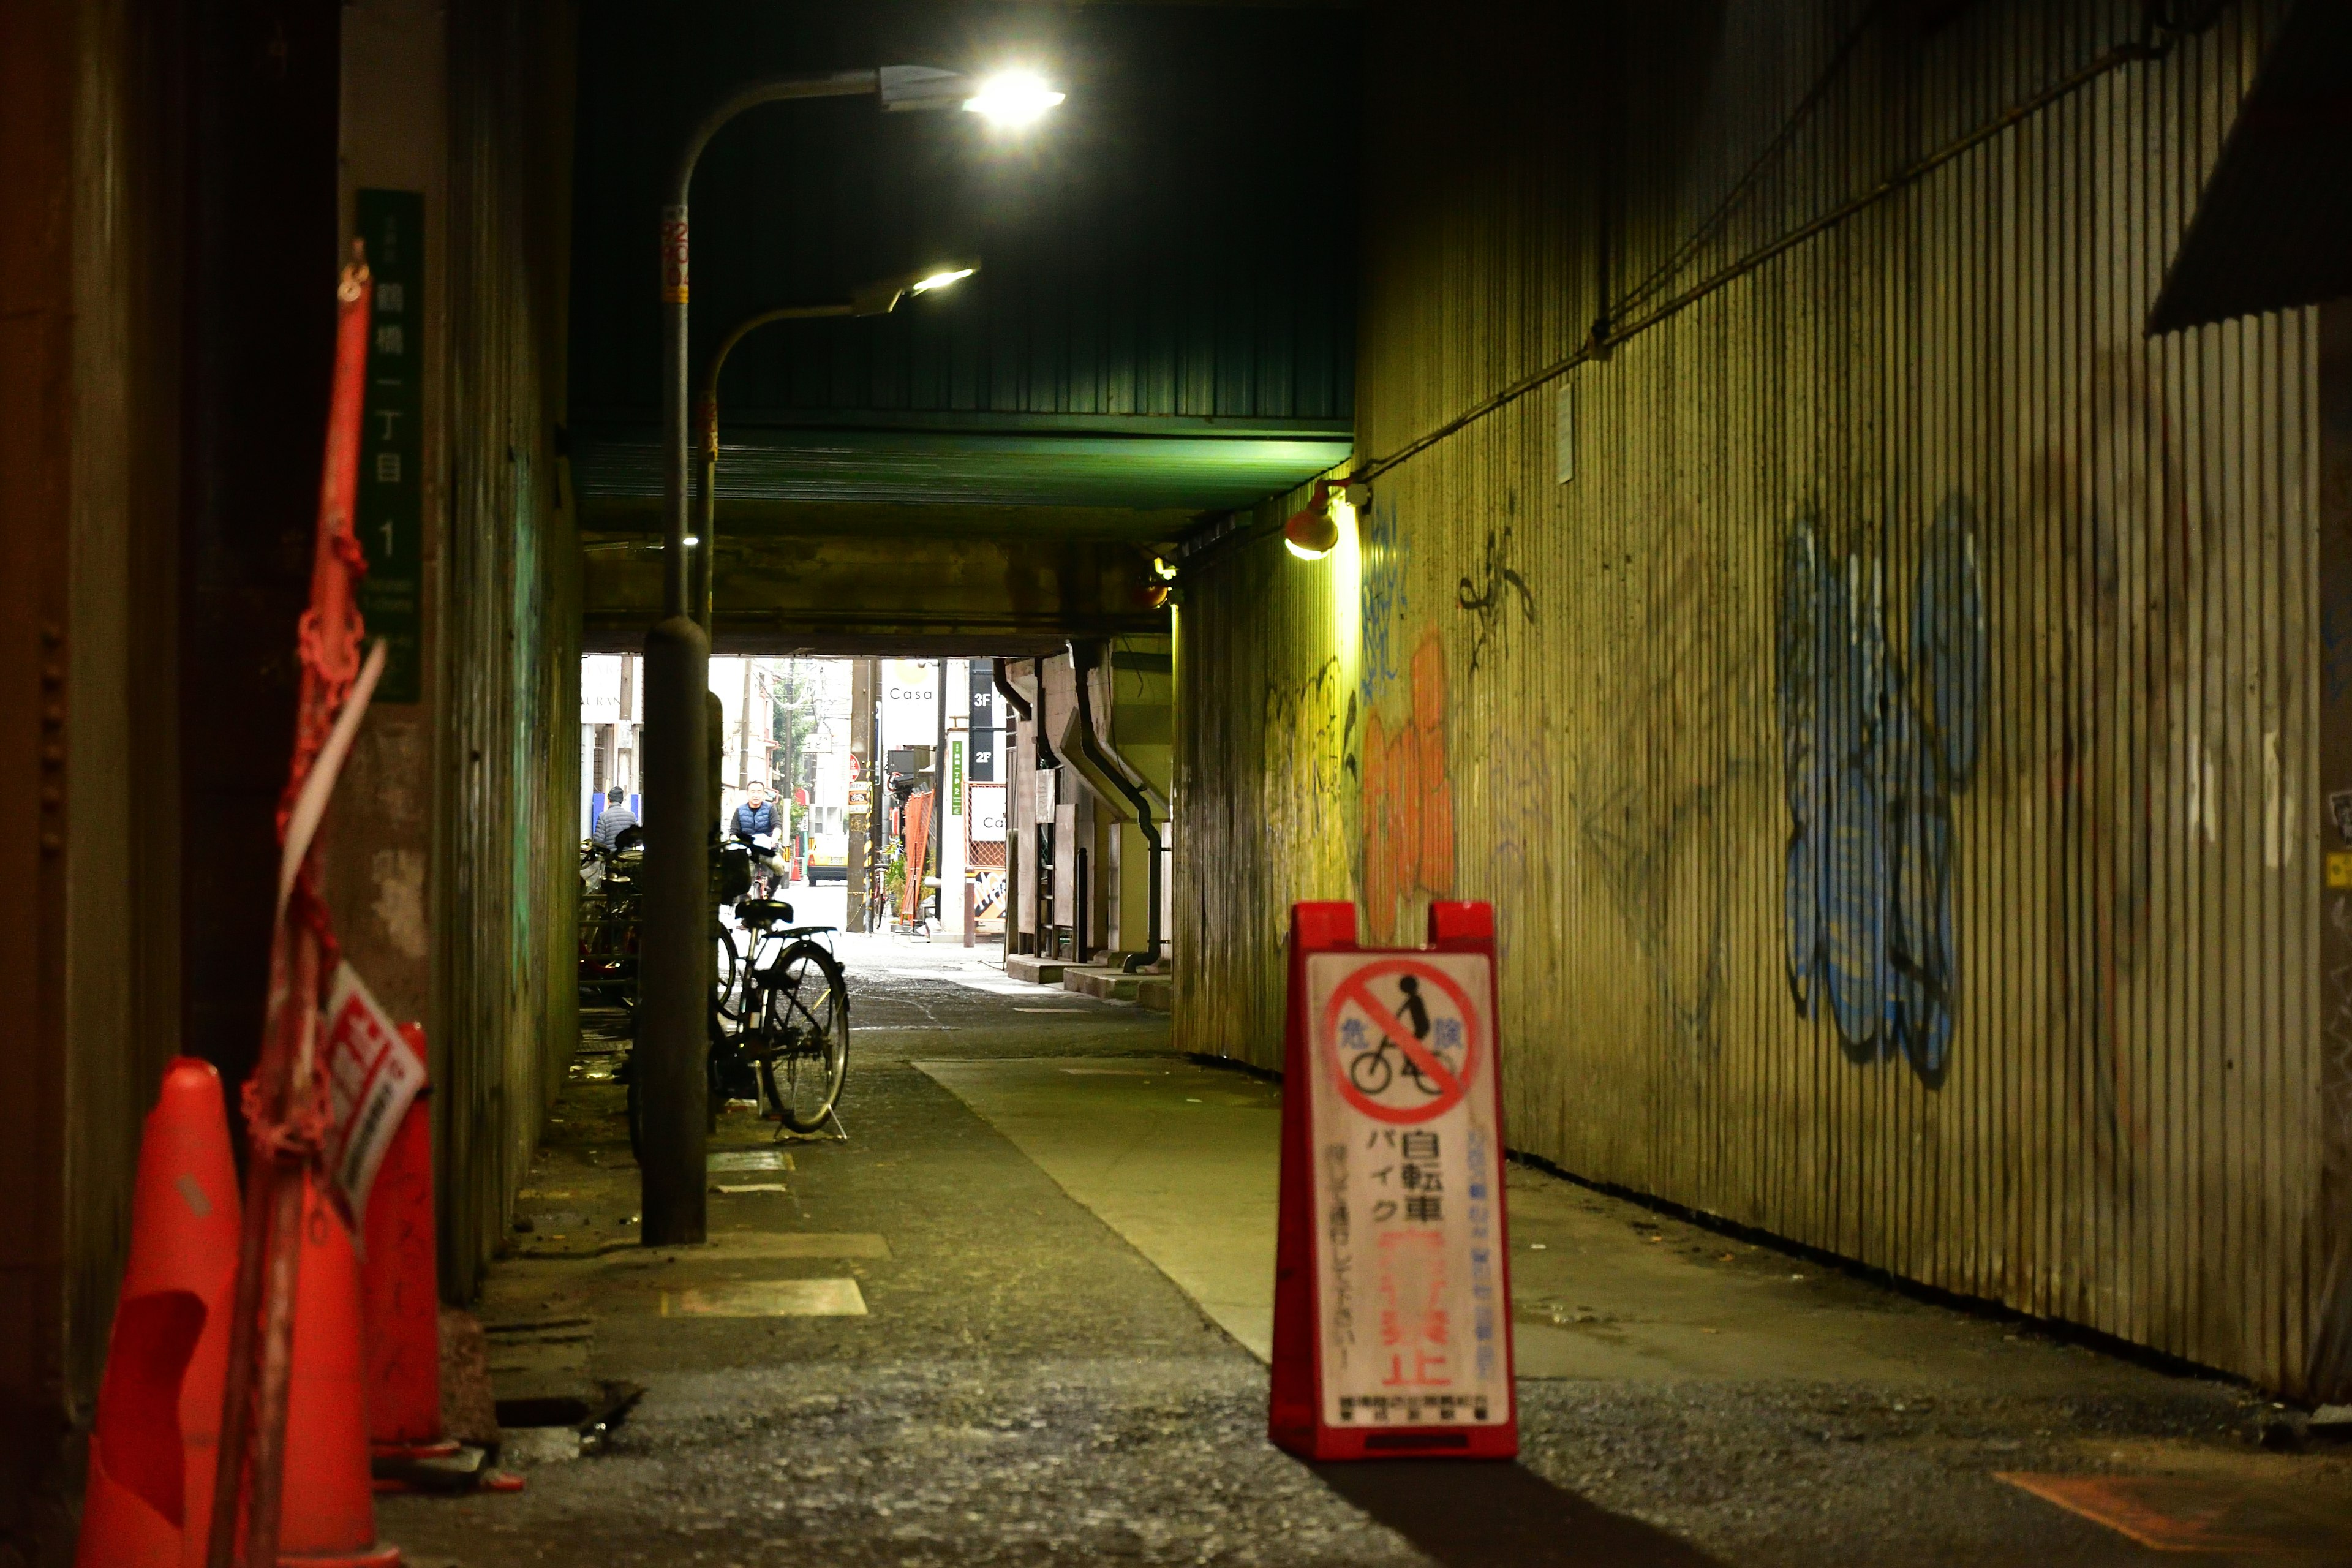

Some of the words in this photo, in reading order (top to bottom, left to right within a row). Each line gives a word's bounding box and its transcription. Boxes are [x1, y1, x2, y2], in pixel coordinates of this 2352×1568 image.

[379, 520, 393, 556] 1
[890, 688, 932, 699] Casa
[974, 693, 992, 707] 3F
[976, 752, 992, 763] 2F
[1366, 1128, 1399, 1223] バイク
[1402, 1129, 1444, 1223] 自転車
